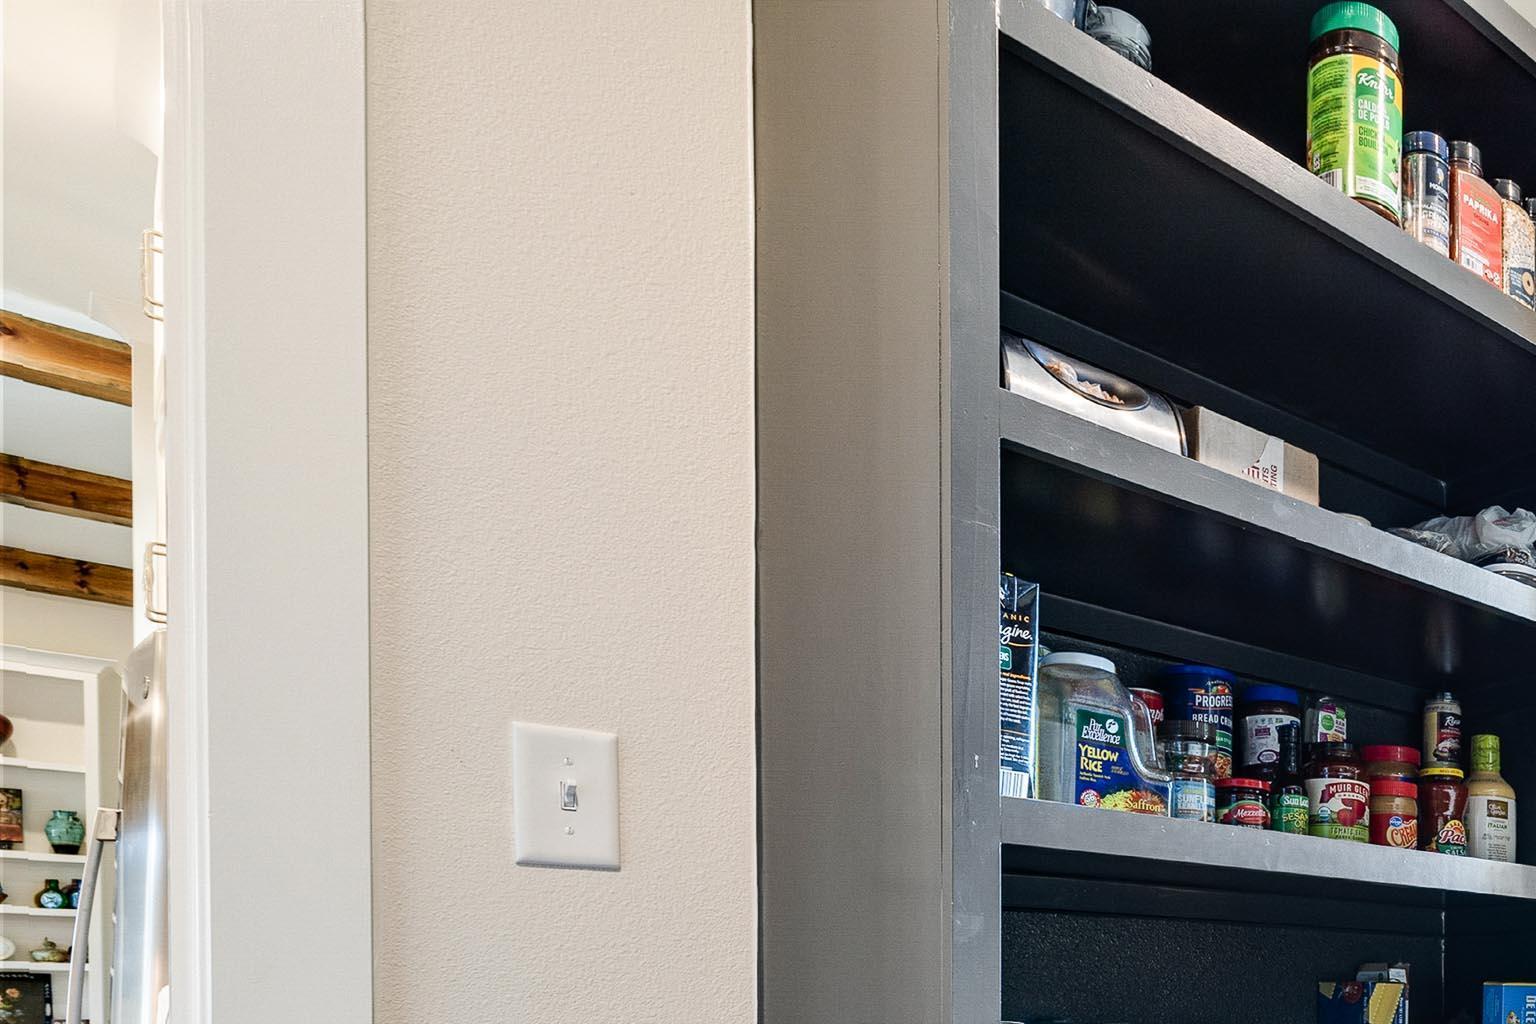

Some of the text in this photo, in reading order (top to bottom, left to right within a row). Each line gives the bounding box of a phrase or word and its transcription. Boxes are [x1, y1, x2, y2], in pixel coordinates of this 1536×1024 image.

[1463, 193, 1498, 225] PAPRIKA
[1089, 718, 1103, 733] Par
[1192, 713, 1218, 724] BREAD
[1081, 725, 1121, 745] Excellence
[1079, 743, 1119, 762] YELLOW
[1080, 757, 1103, 773] RICE
[1329, 783, 1352, 795] MUIR
[1126, 798, 1161, 813] Saffron
[1233, 807, 1267, 819] Mezzetta
[1487, 822, 1507, 830] ITALIAN
[1526, 995, 1536, 1009] DE
